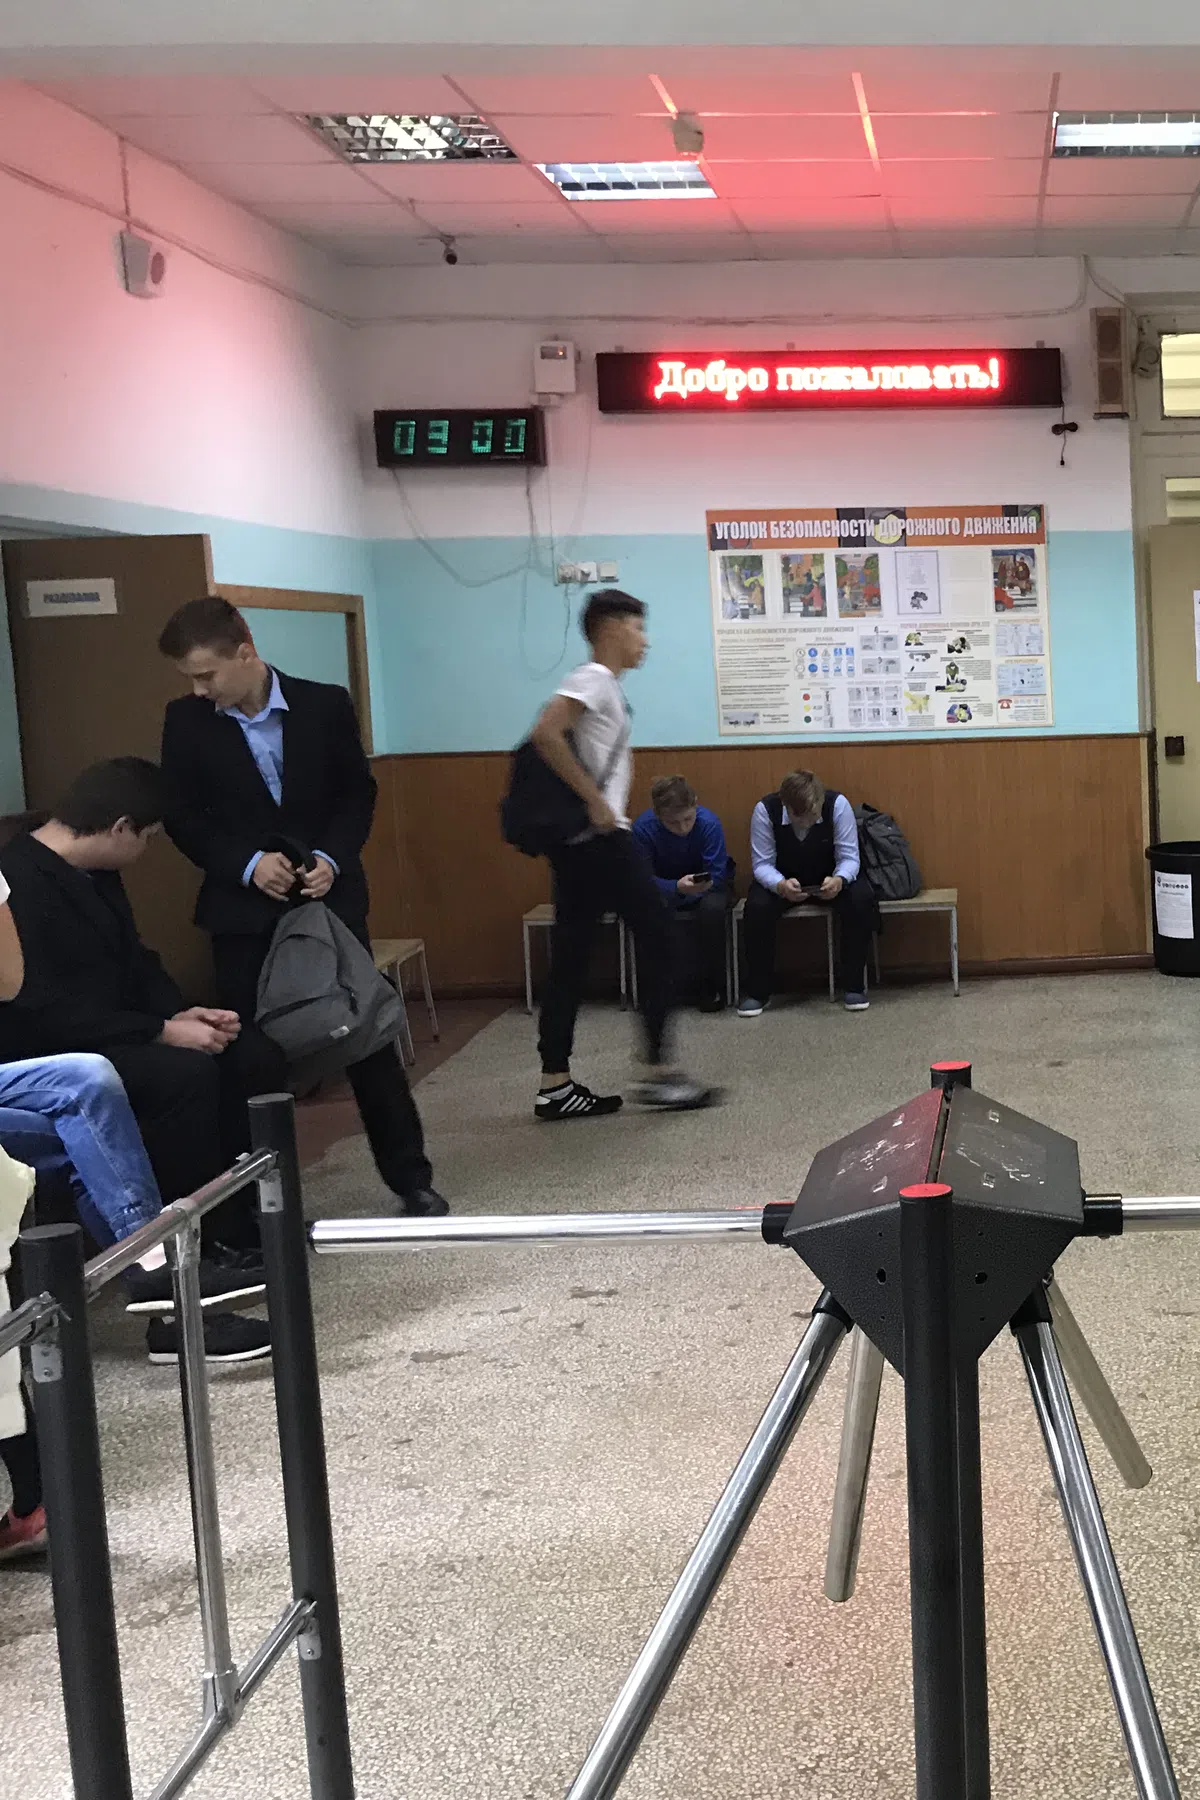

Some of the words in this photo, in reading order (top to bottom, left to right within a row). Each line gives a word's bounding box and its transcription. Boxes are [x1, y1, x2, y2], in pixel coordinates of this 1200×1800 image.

[654, 359, 769, 400] Добро
[776, 357, 999, 390] пожаловать!
[715, 521, 767, 540] УГОЛОК
[770, 519, 875, 538] БЕЗОПАСНОСТИ
[878, 517, 960, 538] ДОРОЖНОГО
[963, 516, 1037, 538] ДВИЖЕНИЯ
